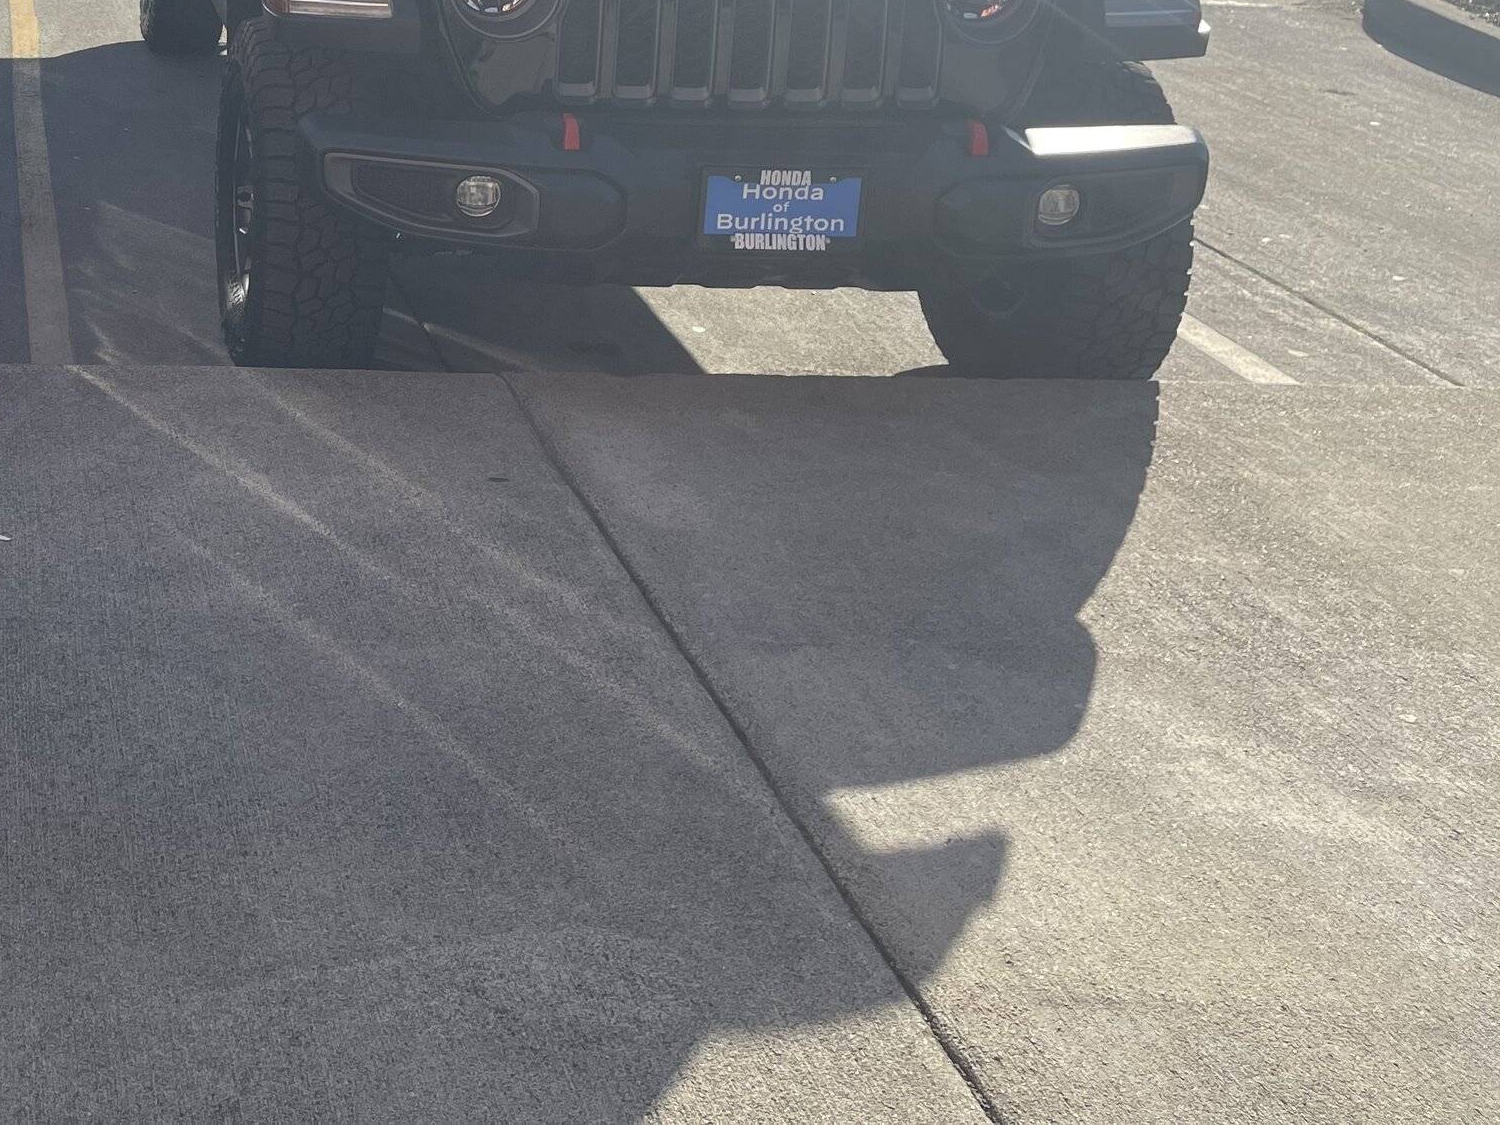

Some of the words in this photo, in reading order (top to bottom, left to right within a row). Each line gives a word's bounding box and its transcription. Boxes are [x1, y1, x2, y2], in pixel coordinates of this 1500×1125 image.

[759, 170, 812, 186] HONDA
[742, 183, 824, 201] Honda
[772, 201, 790, 213] of
[716, 213, 845, 234] Burlington
[734, 233, 826, 251] BURLINGTON
